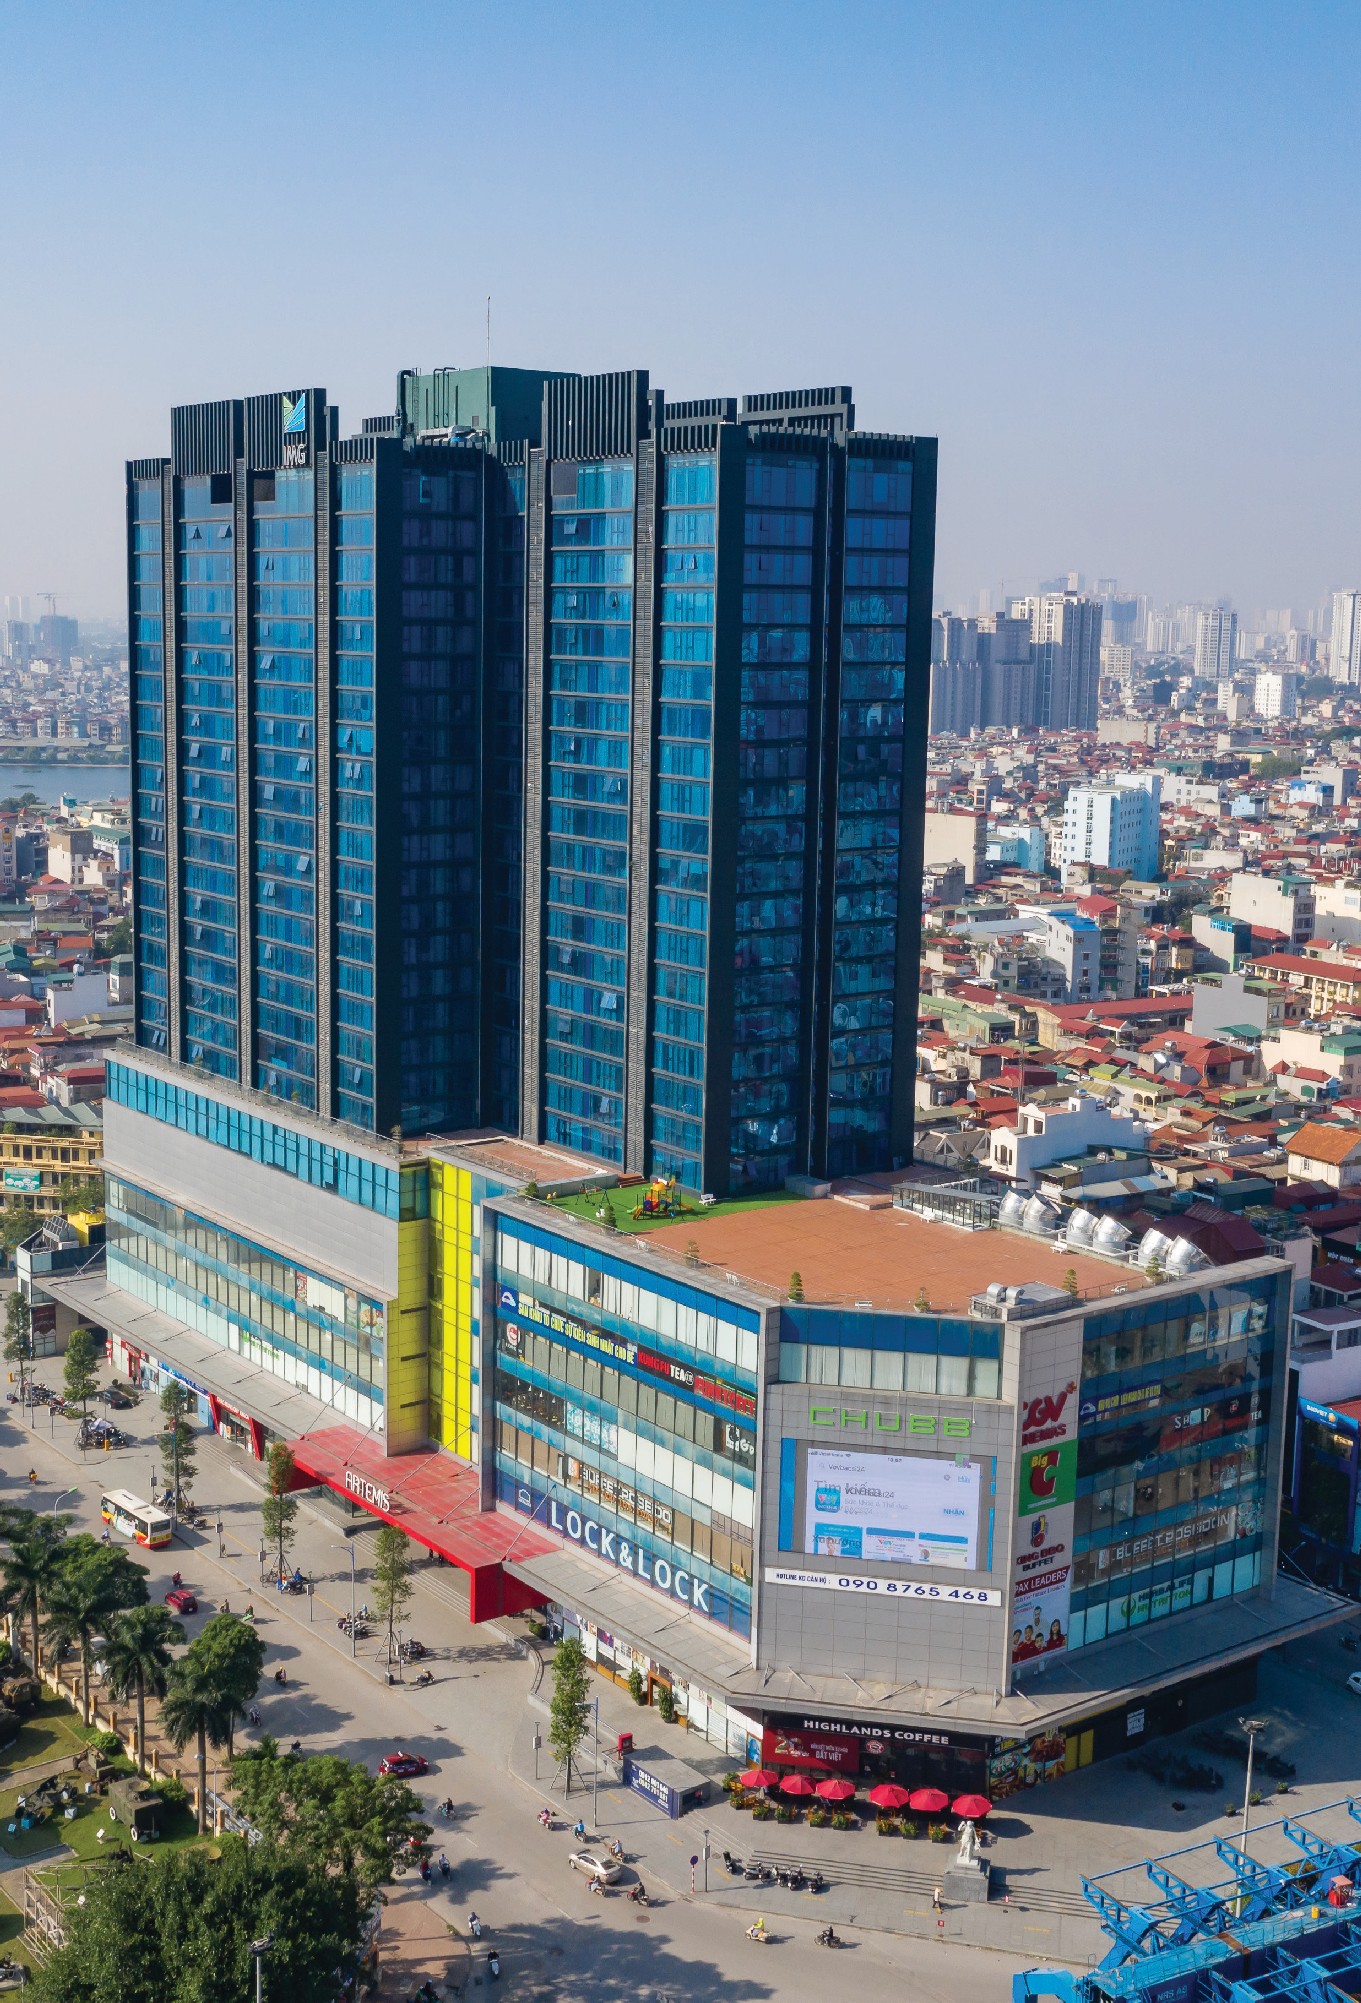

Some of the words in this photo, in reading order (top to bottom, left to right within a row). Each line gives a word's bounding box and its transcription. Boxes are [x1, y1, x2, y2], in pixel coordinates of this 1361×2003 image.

[670, 1365, 686, 1382] TEA
[809, 1407, 972, 1437] CHUBB
[1250, 1410, 1262, 1421] TEA
[1030, 1455, 1048, 1468] Big
[1030, 1450, 1060, 1497] C
[345, 1471, 390, 1512] ARTEMIS
[551, 1501, 709, 1612] LOCK&LOCK
[1022, 1556, 1056, 1572] BUFFET
[838, 1578, 878, 1590] 090
[886, 1583, 940, 1597] 8765
[948, 1589, 988, 1602] 468
[1031, 1570, 1067, 1589] LEADERS
[804, 1720, 891, 1738] HIGHLANDS
[894, 1731, 949, 1745] COFFEE
